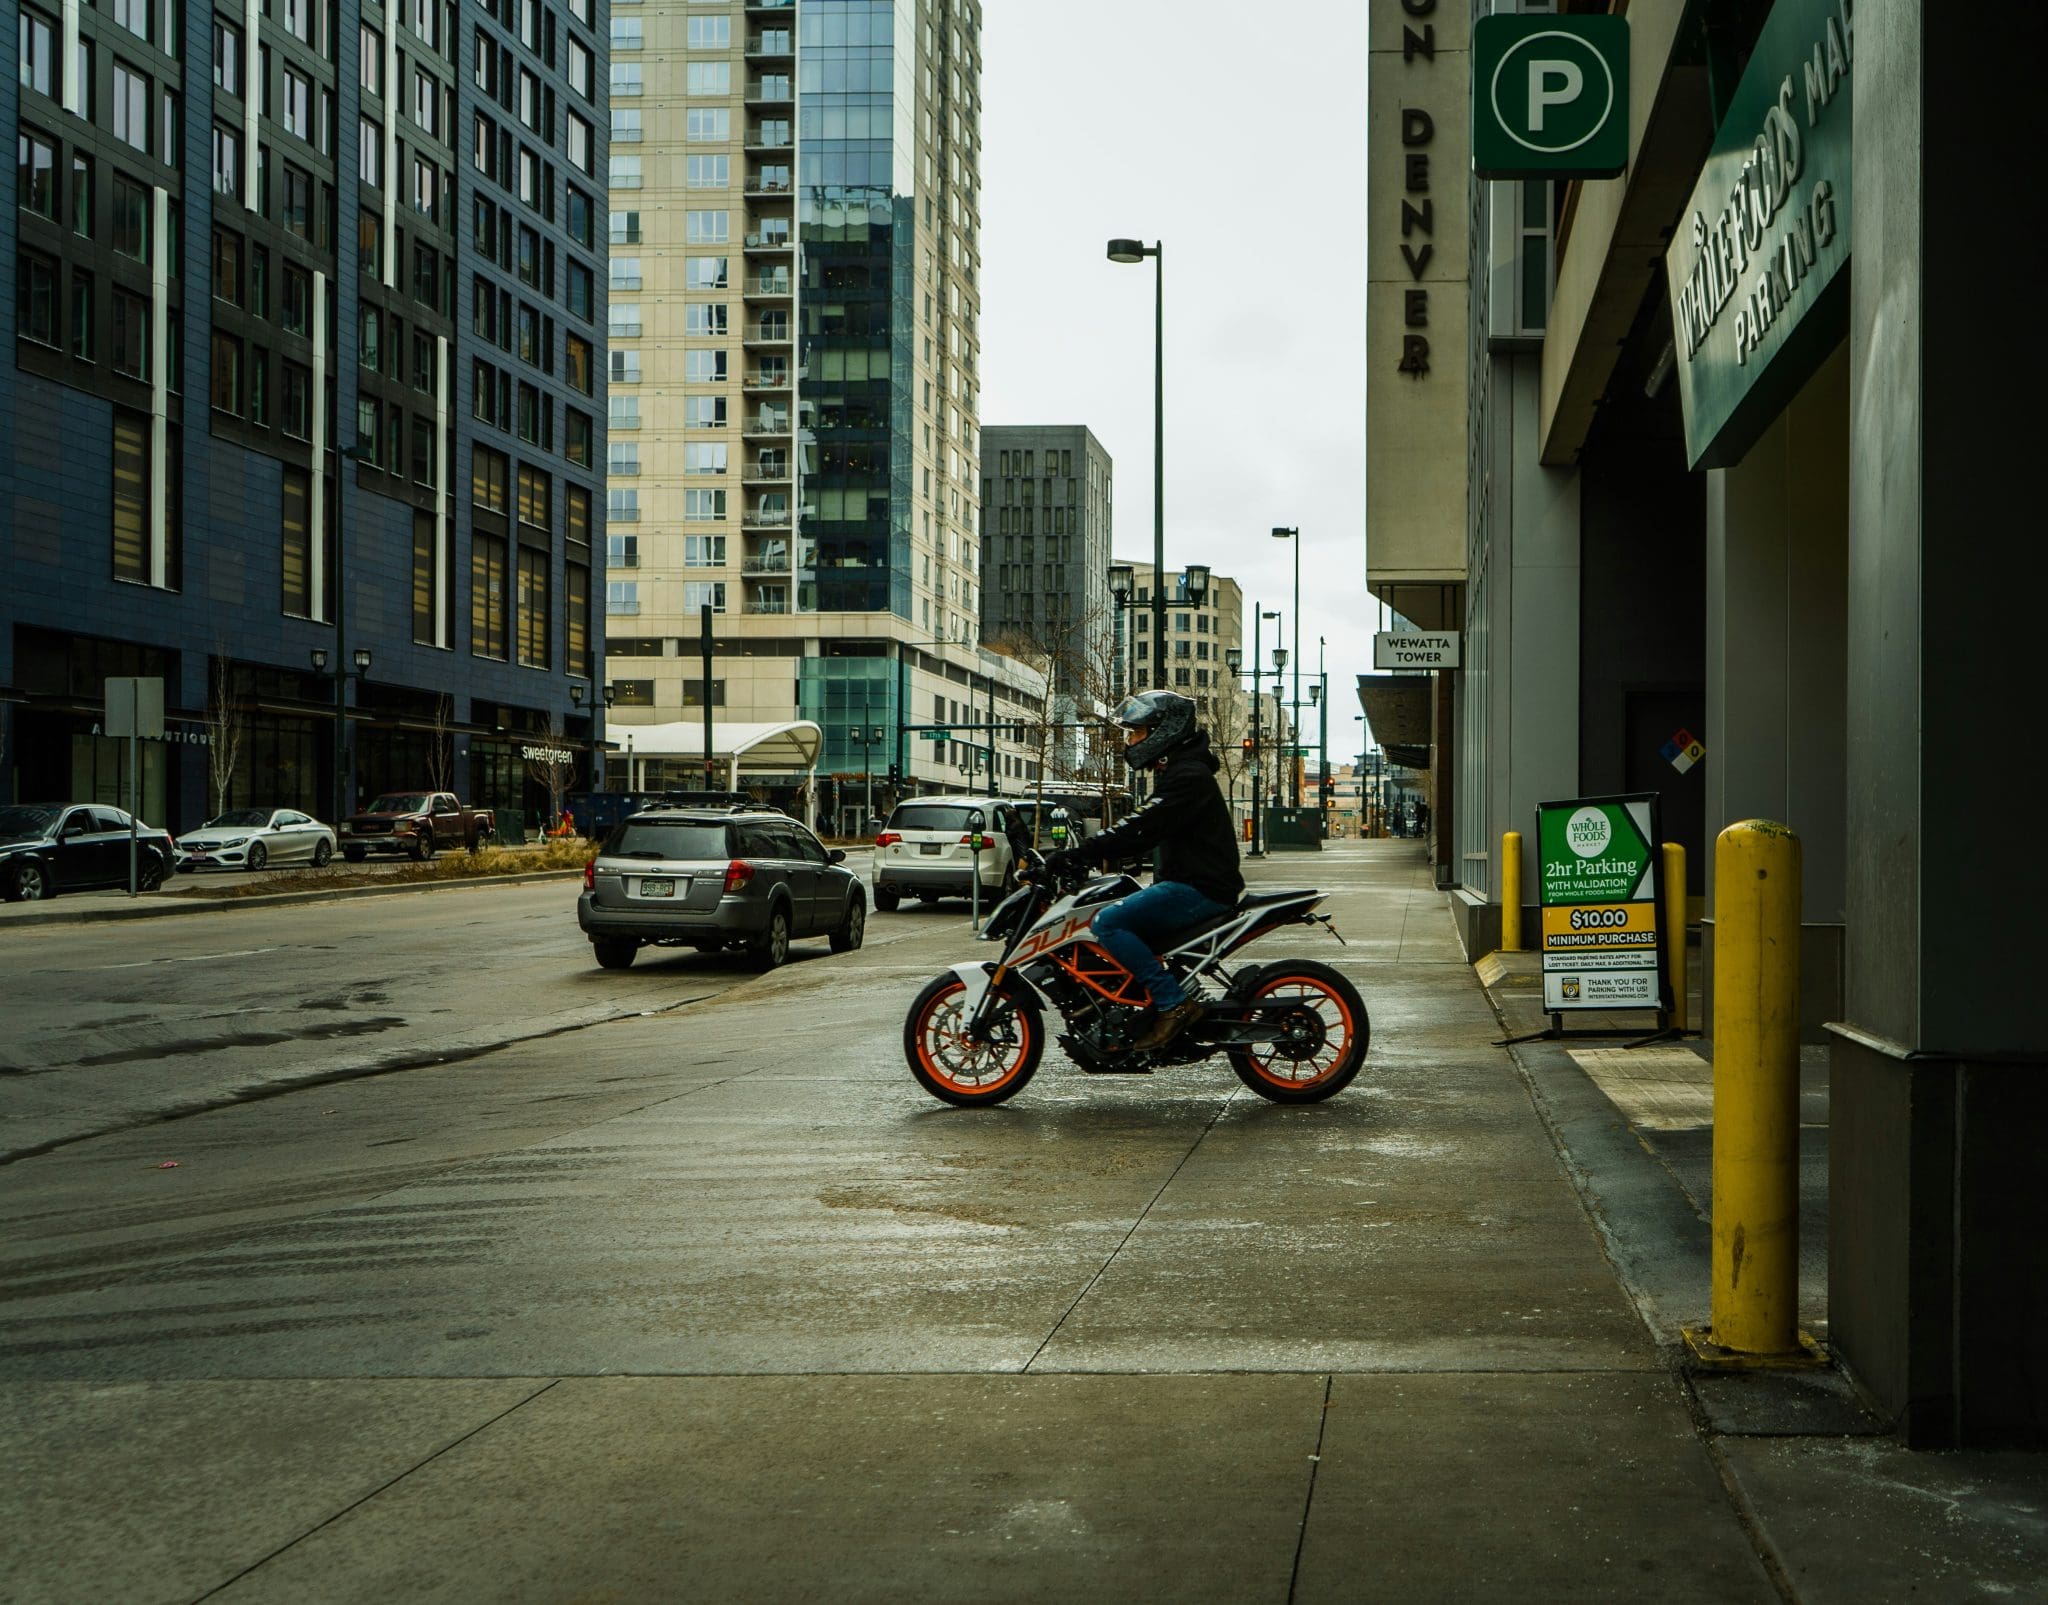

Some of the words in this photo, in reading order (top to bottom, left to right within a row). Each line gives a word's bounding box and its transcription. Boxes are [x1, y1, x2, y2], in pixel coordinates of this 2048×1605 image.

[1527, 59, 1583, 131] P
[1677, 209, 1738, 362] WHOLE
[1731, 74, 1801, 275] FOODS
[1400, 108, 1434, 372] DENVER
[1733, 180, 1833, 366] PARKING
[1387, 638, 1450, 648] WEWATTA
[1396, 652, 1441, 662] TOWER
[522, 745, 573, 765] sweetgreen
[1571, 821, 1606, 832] WHOLE
[1573, 831, 1606, 842] FOODS
[1546, 861, 1573, 877] 2hr
[1576, 858, 1637, 876] Parking
[1546, 881, 1571, 891] WITH
[1573, 878, 1627, 889] VALIDATION
[1571, 910, 1627, 929] $10.00
[1548, 935, 1596, 946] MINIMUM
[1599, 932, 1655, 944] PURCHASE
